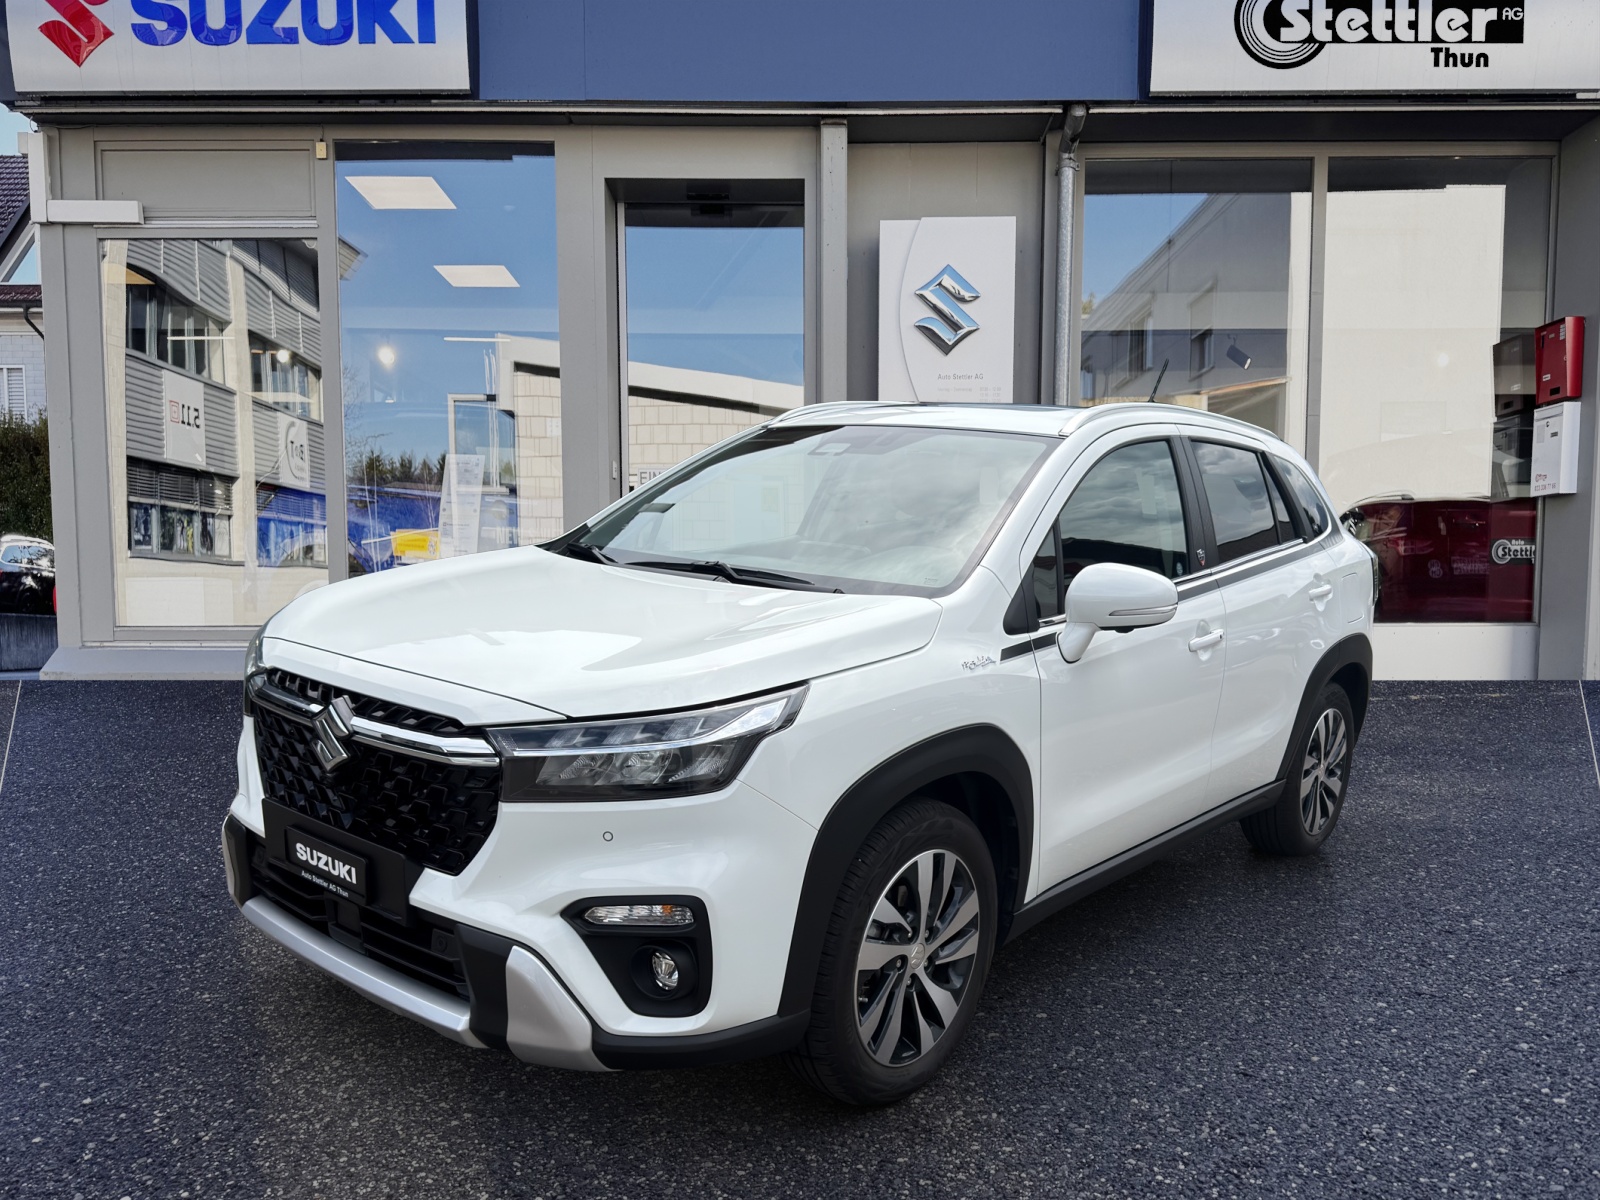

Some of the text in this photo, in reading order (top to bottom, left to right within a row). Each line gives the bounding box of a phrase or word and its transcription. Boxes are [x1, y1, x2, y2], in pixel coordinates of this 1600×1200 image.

[131, 0, 436, 46] SUZUKI
[1280, 0, 1524, 43] Stettler AG
[1430, 47, 1489, 68] Thun
[1501, 546, 1536, 558] Stettl
[295, 842, 357, 885] SUZUKI
[301, 870, 313, 880] Auto
[328, 883, 337, 892] AG
[336, 886, 349, 898] Thun
